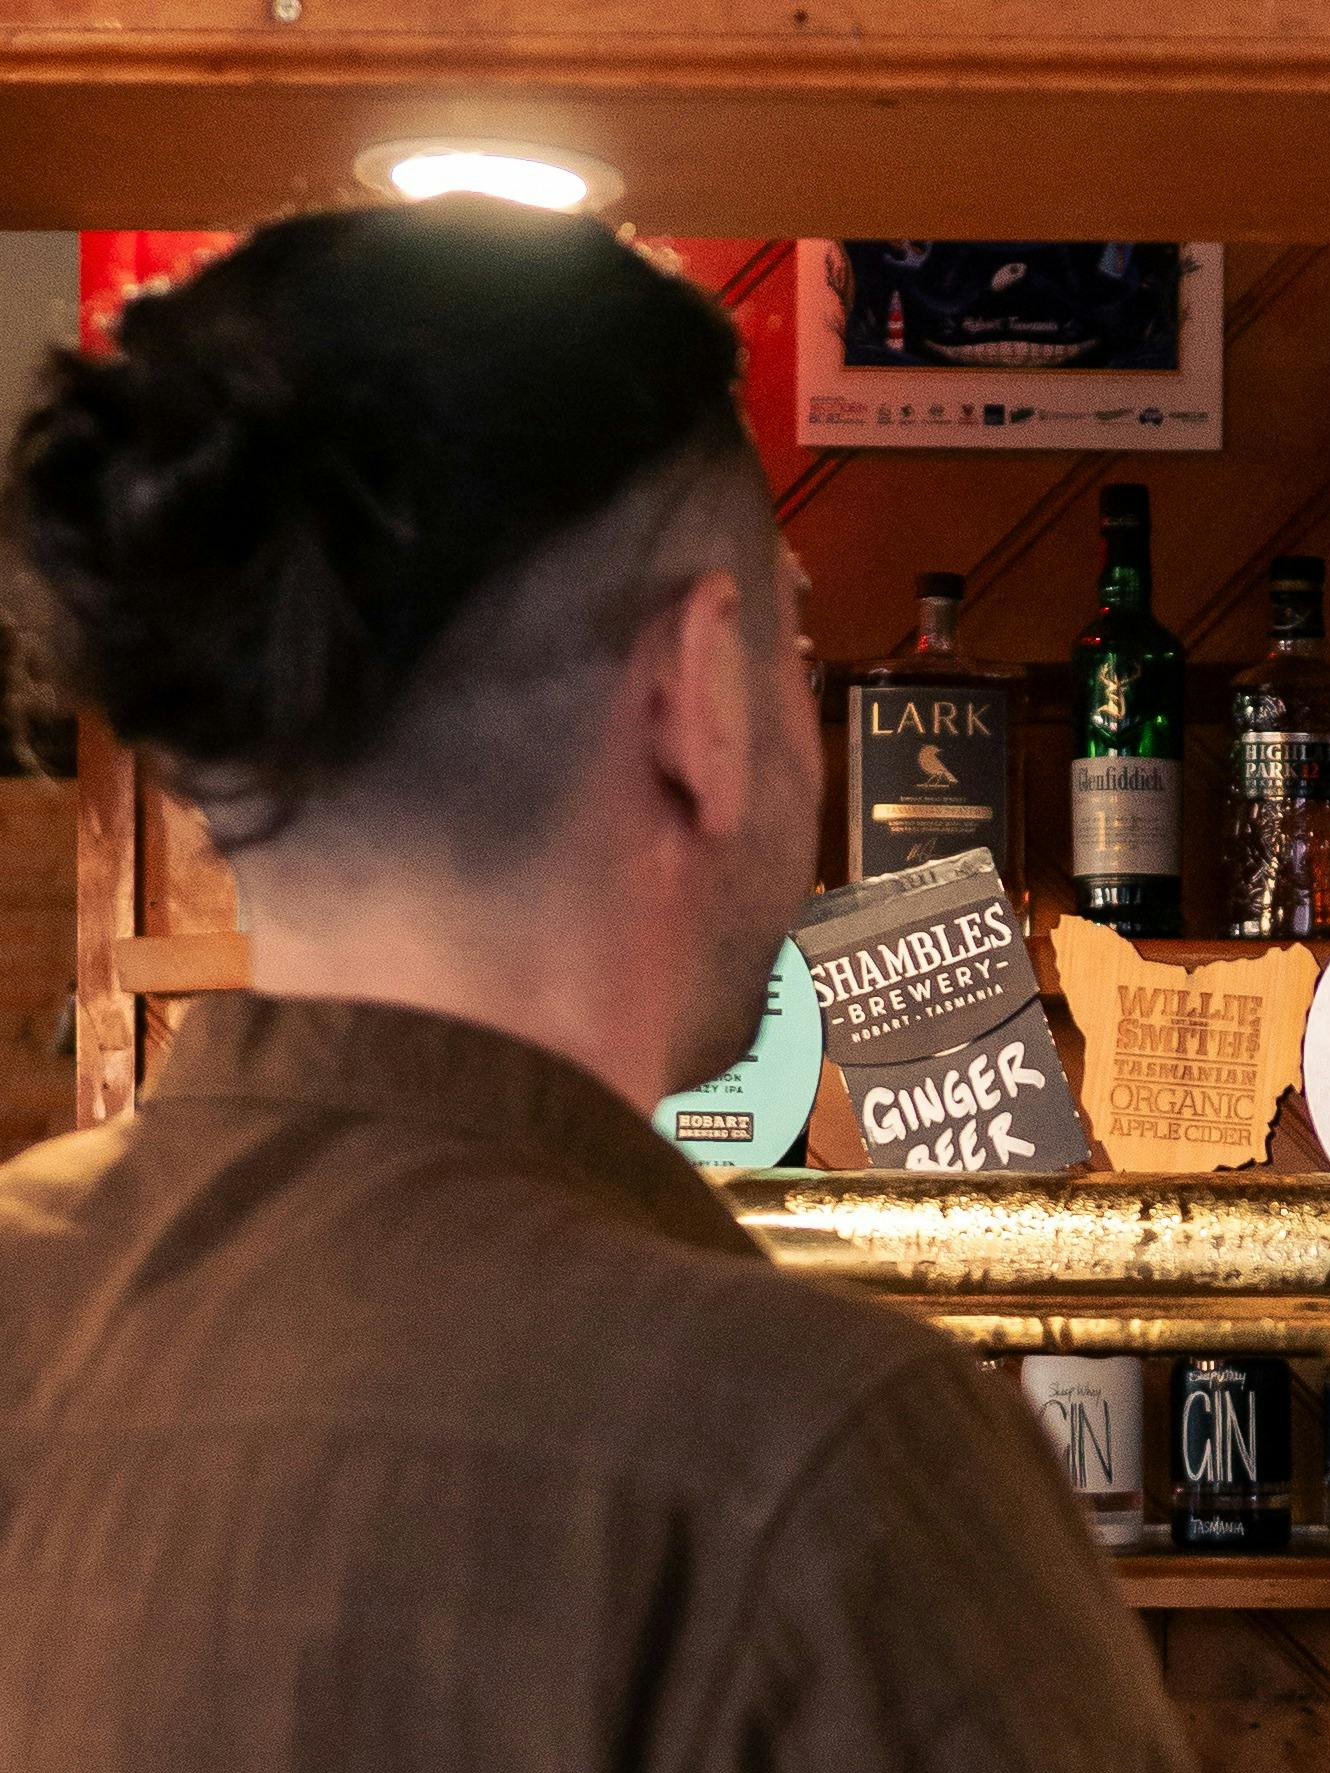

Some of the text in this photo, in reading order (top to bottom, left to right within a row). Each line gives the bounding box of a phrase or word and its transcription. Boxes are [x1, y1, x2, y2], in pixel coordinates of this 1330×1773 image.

[871, 702, 991, 736] LARK
[1245, 762, 1298, 780] PARK
[810, 902, 1013, 1008] SHAMBLES
[851, 983, 1005, 1043] HOBART TASMANIA
[1117, 984, 1264, 1026] WILLIE
[725, 1086, 744, 1094] IPA
[1114, 1058, 1258, 1087] TASMANIAN
[863, 1041, 1046, 1147] GINGER
[1109, 1083, 1257, 1121] ORGANIC
[678, 1114, 751, 1129] HOBART
[1109, 1117, 1253, 1147] APPLE CIDER
[905, 1111, 1036, 1171] BEER
[1182, 1390, 1257, 1483] GIN
[1190, 1514, 1246, 1537] TASMANIA
